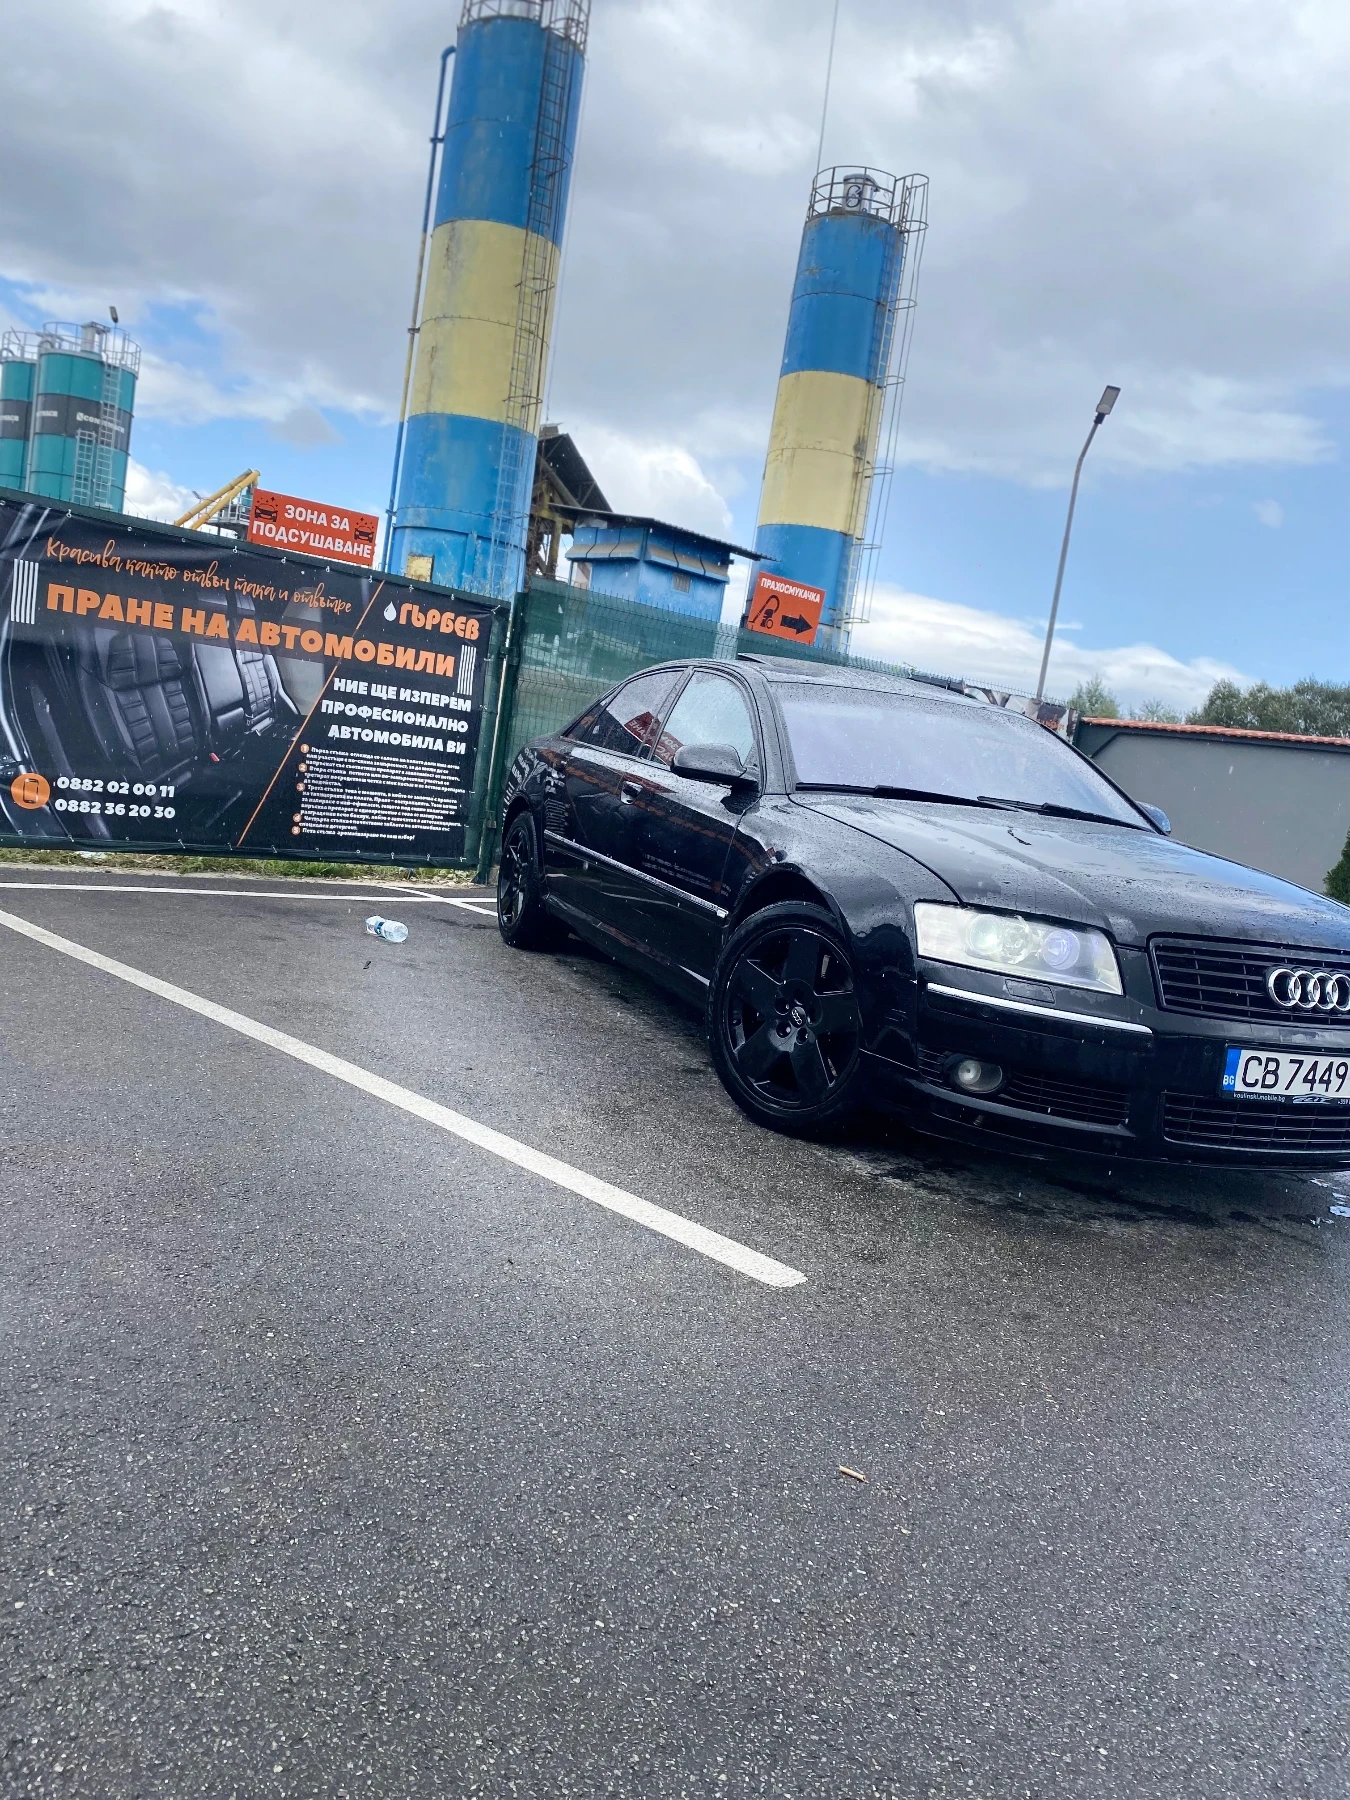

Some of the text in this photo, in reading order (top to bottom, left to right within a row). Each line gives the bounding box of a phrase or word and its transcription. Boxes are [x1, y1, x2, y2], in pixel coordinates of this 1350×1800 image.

[284, 504, 350, 531] ЗОНА ЗА
[252, 521, 372, 558] ПОДСУШАВАНЕ
[47, 537, 352, 615] Красива както отвън така и отвътре
[760, 578, 821, 604] ПРАХОСМУКАЧКА
[47, 583, 456, 677] ПРАНЕ НА АВТОМОБИЛИ
[399, 603, 480, 640] ГЪРБЕВ
[334, 678, 472, 712] НИЕ ЩЕ ИЗПЕРЕМ
[321, 700, 468, 734] ПРОФЕСИОНАЛНО
[328, 724, 466, 755] АВТОМОБИЛА ВИ
[57, 776, 175, 798] 0882 02 00 11
[54, 798, 176, 819] 0882 36 20 30
[1223, 1075, 1234, 1086] BG
[1242, 1056, 1349, 1092] CB 7449
